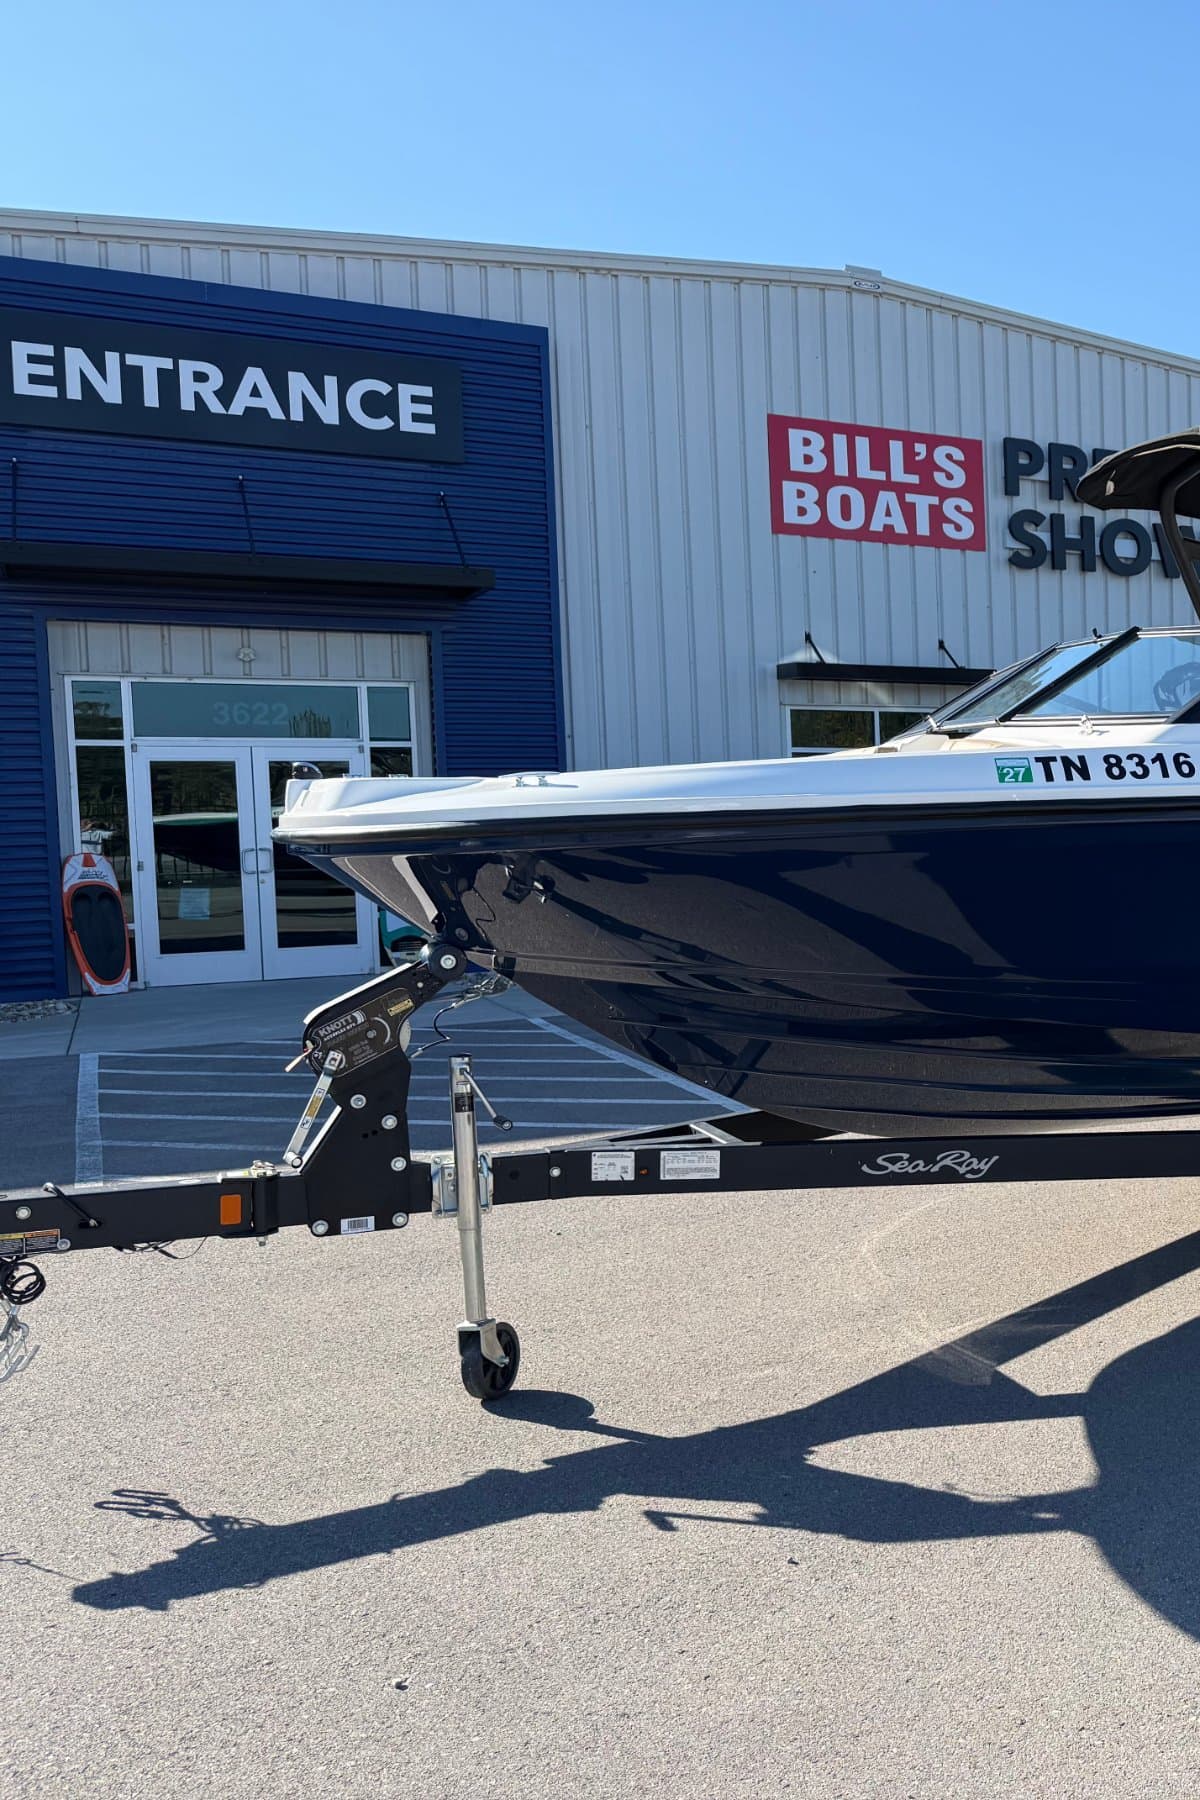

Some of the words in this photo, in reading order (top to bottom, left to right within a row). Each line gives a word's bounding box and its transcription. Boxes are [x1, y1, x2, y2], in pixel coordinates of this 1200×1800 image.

[11, 340, 437, 435] ENTRANCE
[788, 428, 966, 489] BILL'S
[782, 480, 975, 541] BOATS
[212, 701, 289, 725] 3622
[1002, 767, 1026, 782] 27
[1034, 755, 1092, 782] TN
[1102, 752, 1196, 781] 8316
[318, 1014, 354, 1037] KNOTT
[861, 1153, 933, 1175] Sea
[930, 1150, 1000, 1179] Ray
